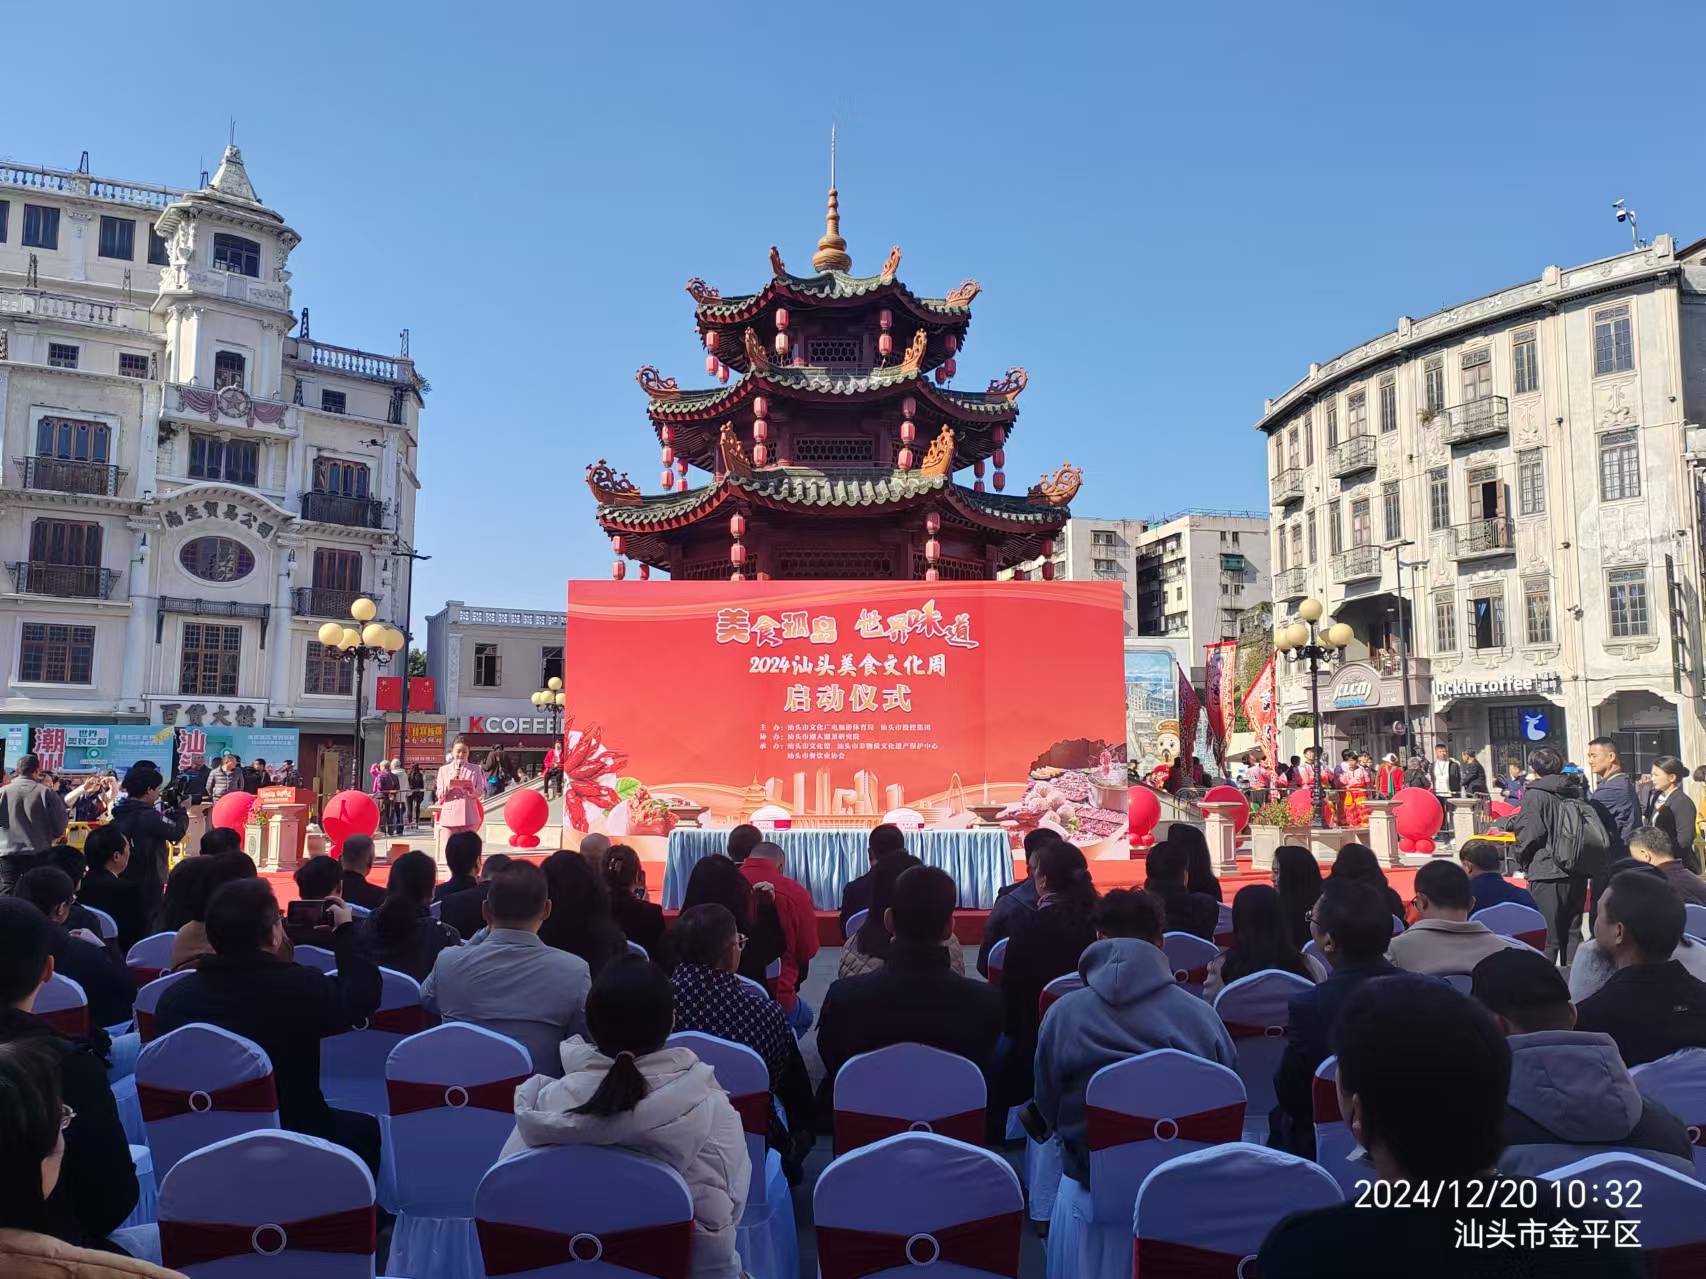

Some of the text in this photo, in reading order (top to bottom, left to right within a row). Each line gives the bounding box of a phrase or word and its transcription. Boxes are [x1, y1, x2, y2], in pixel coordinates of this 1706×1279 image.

[716, 599, 979, 649] 美食孤岛 世界味道
[749, 653, 946, 677] 2024汕头美食文化周
[784, 683, 912, 712] 启动仪式
[1432, 679, 1476, 696] luckin
[1480, 676, 1532, 692] coffee
